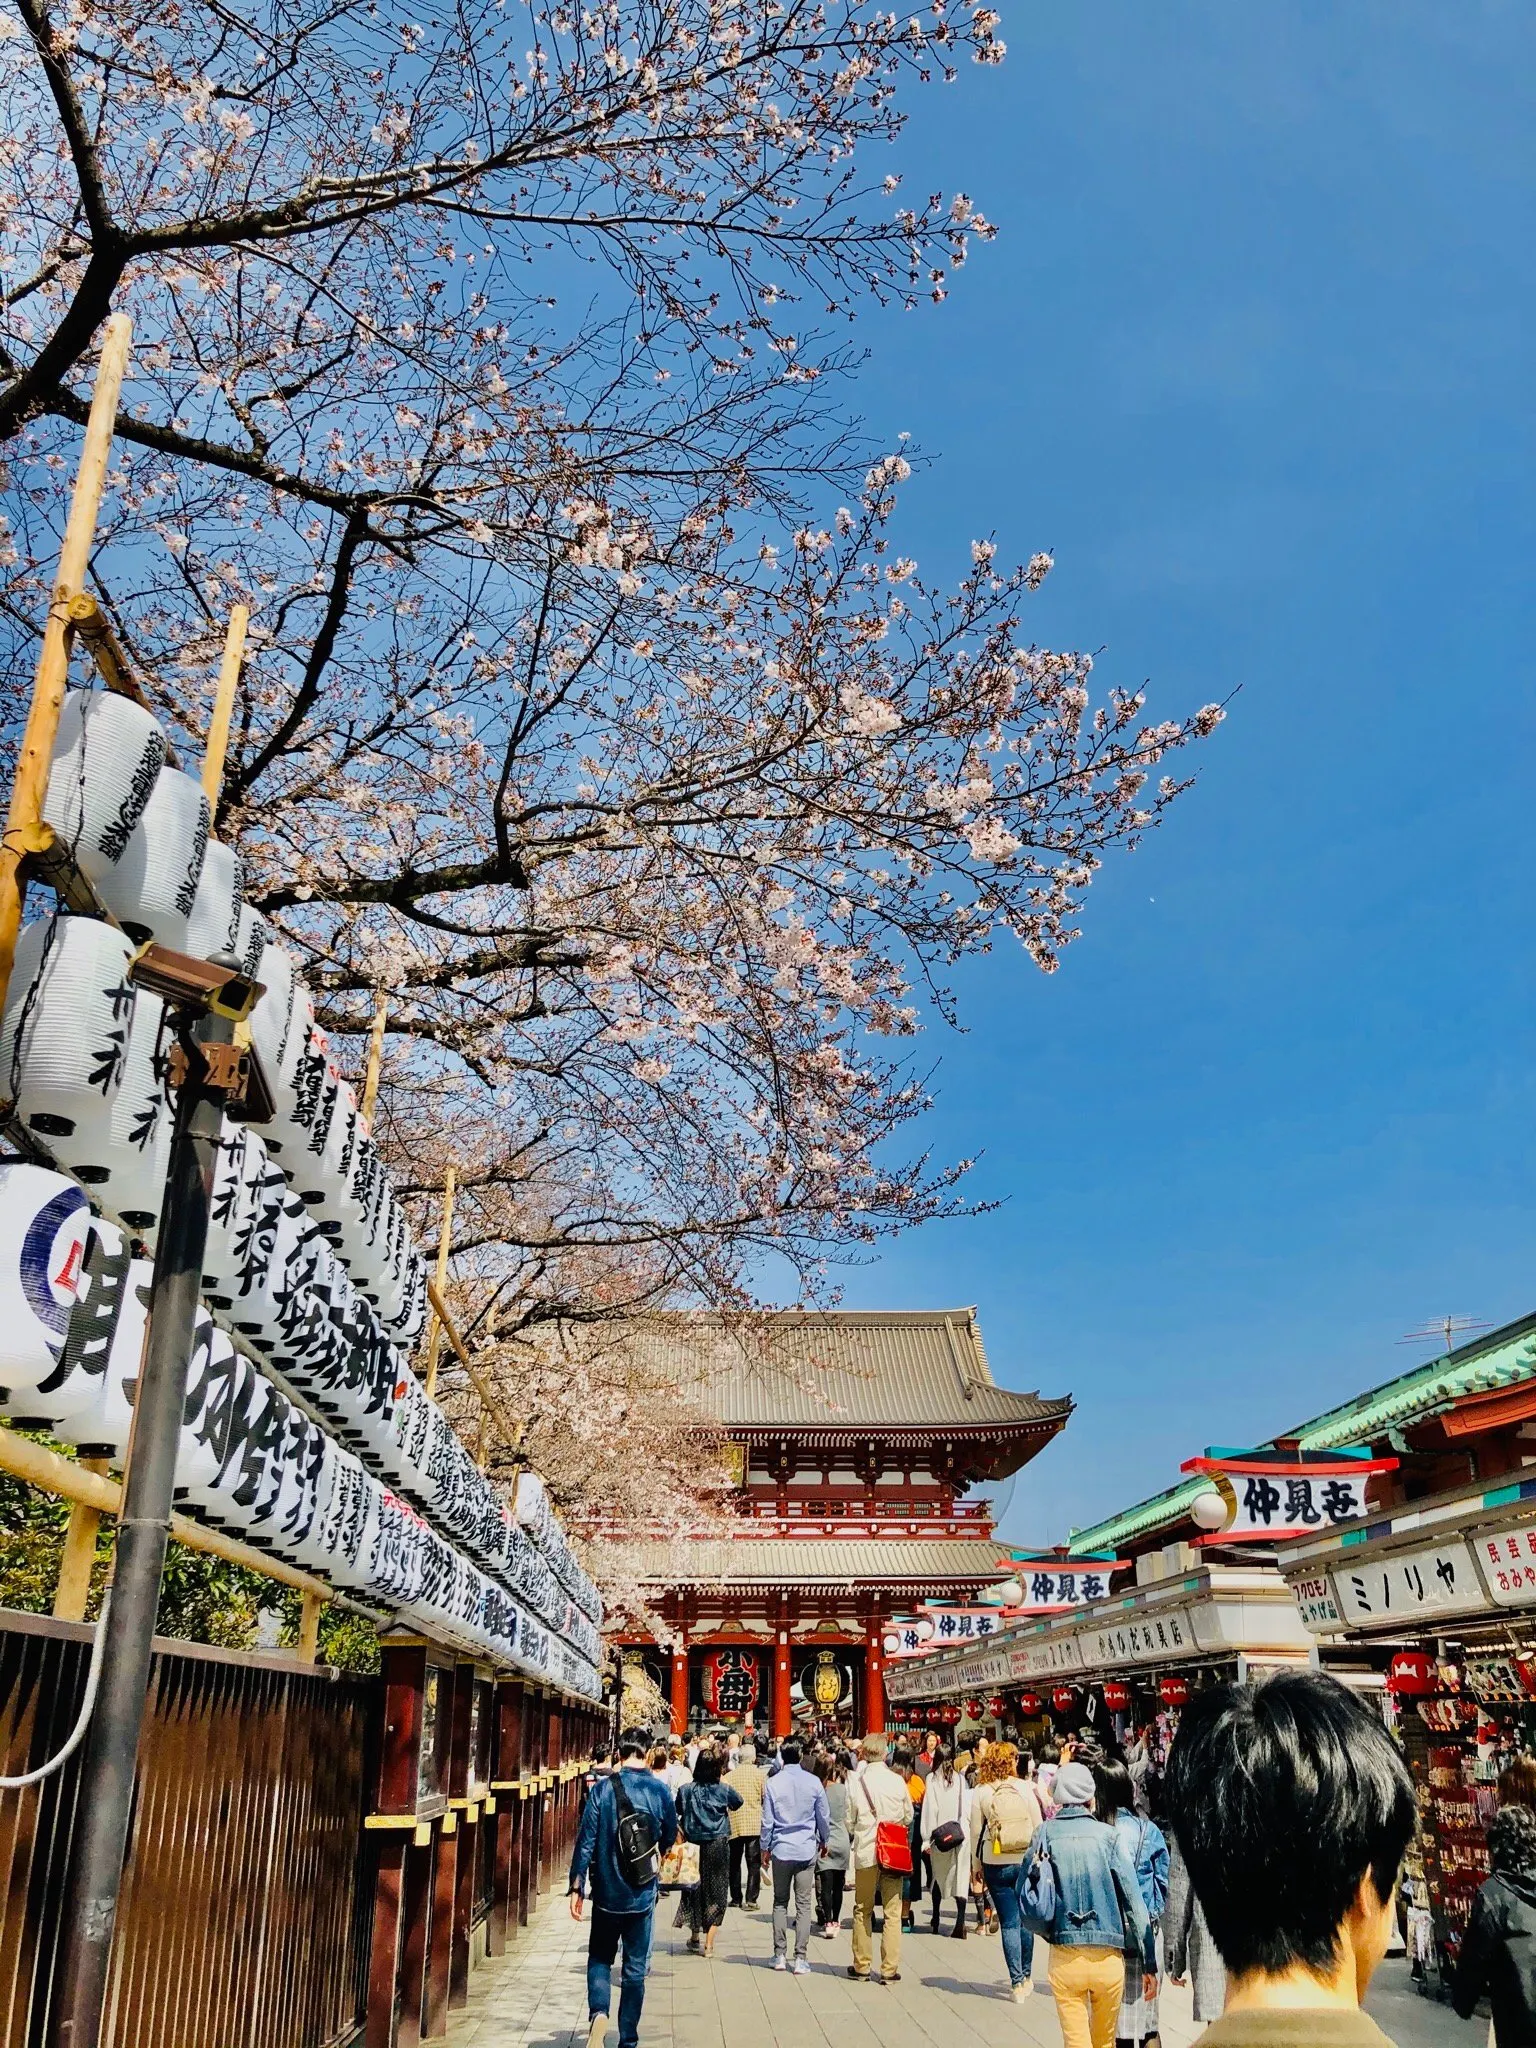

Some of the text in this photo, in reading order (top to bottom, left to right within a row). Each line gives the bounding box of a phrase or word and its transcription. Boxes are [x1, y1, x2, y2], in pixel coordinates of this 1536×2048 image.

[1293, 1579, 1327, 1602] フクロモノ
[1352, 1558, 1454, 1611] ミノリヤ
